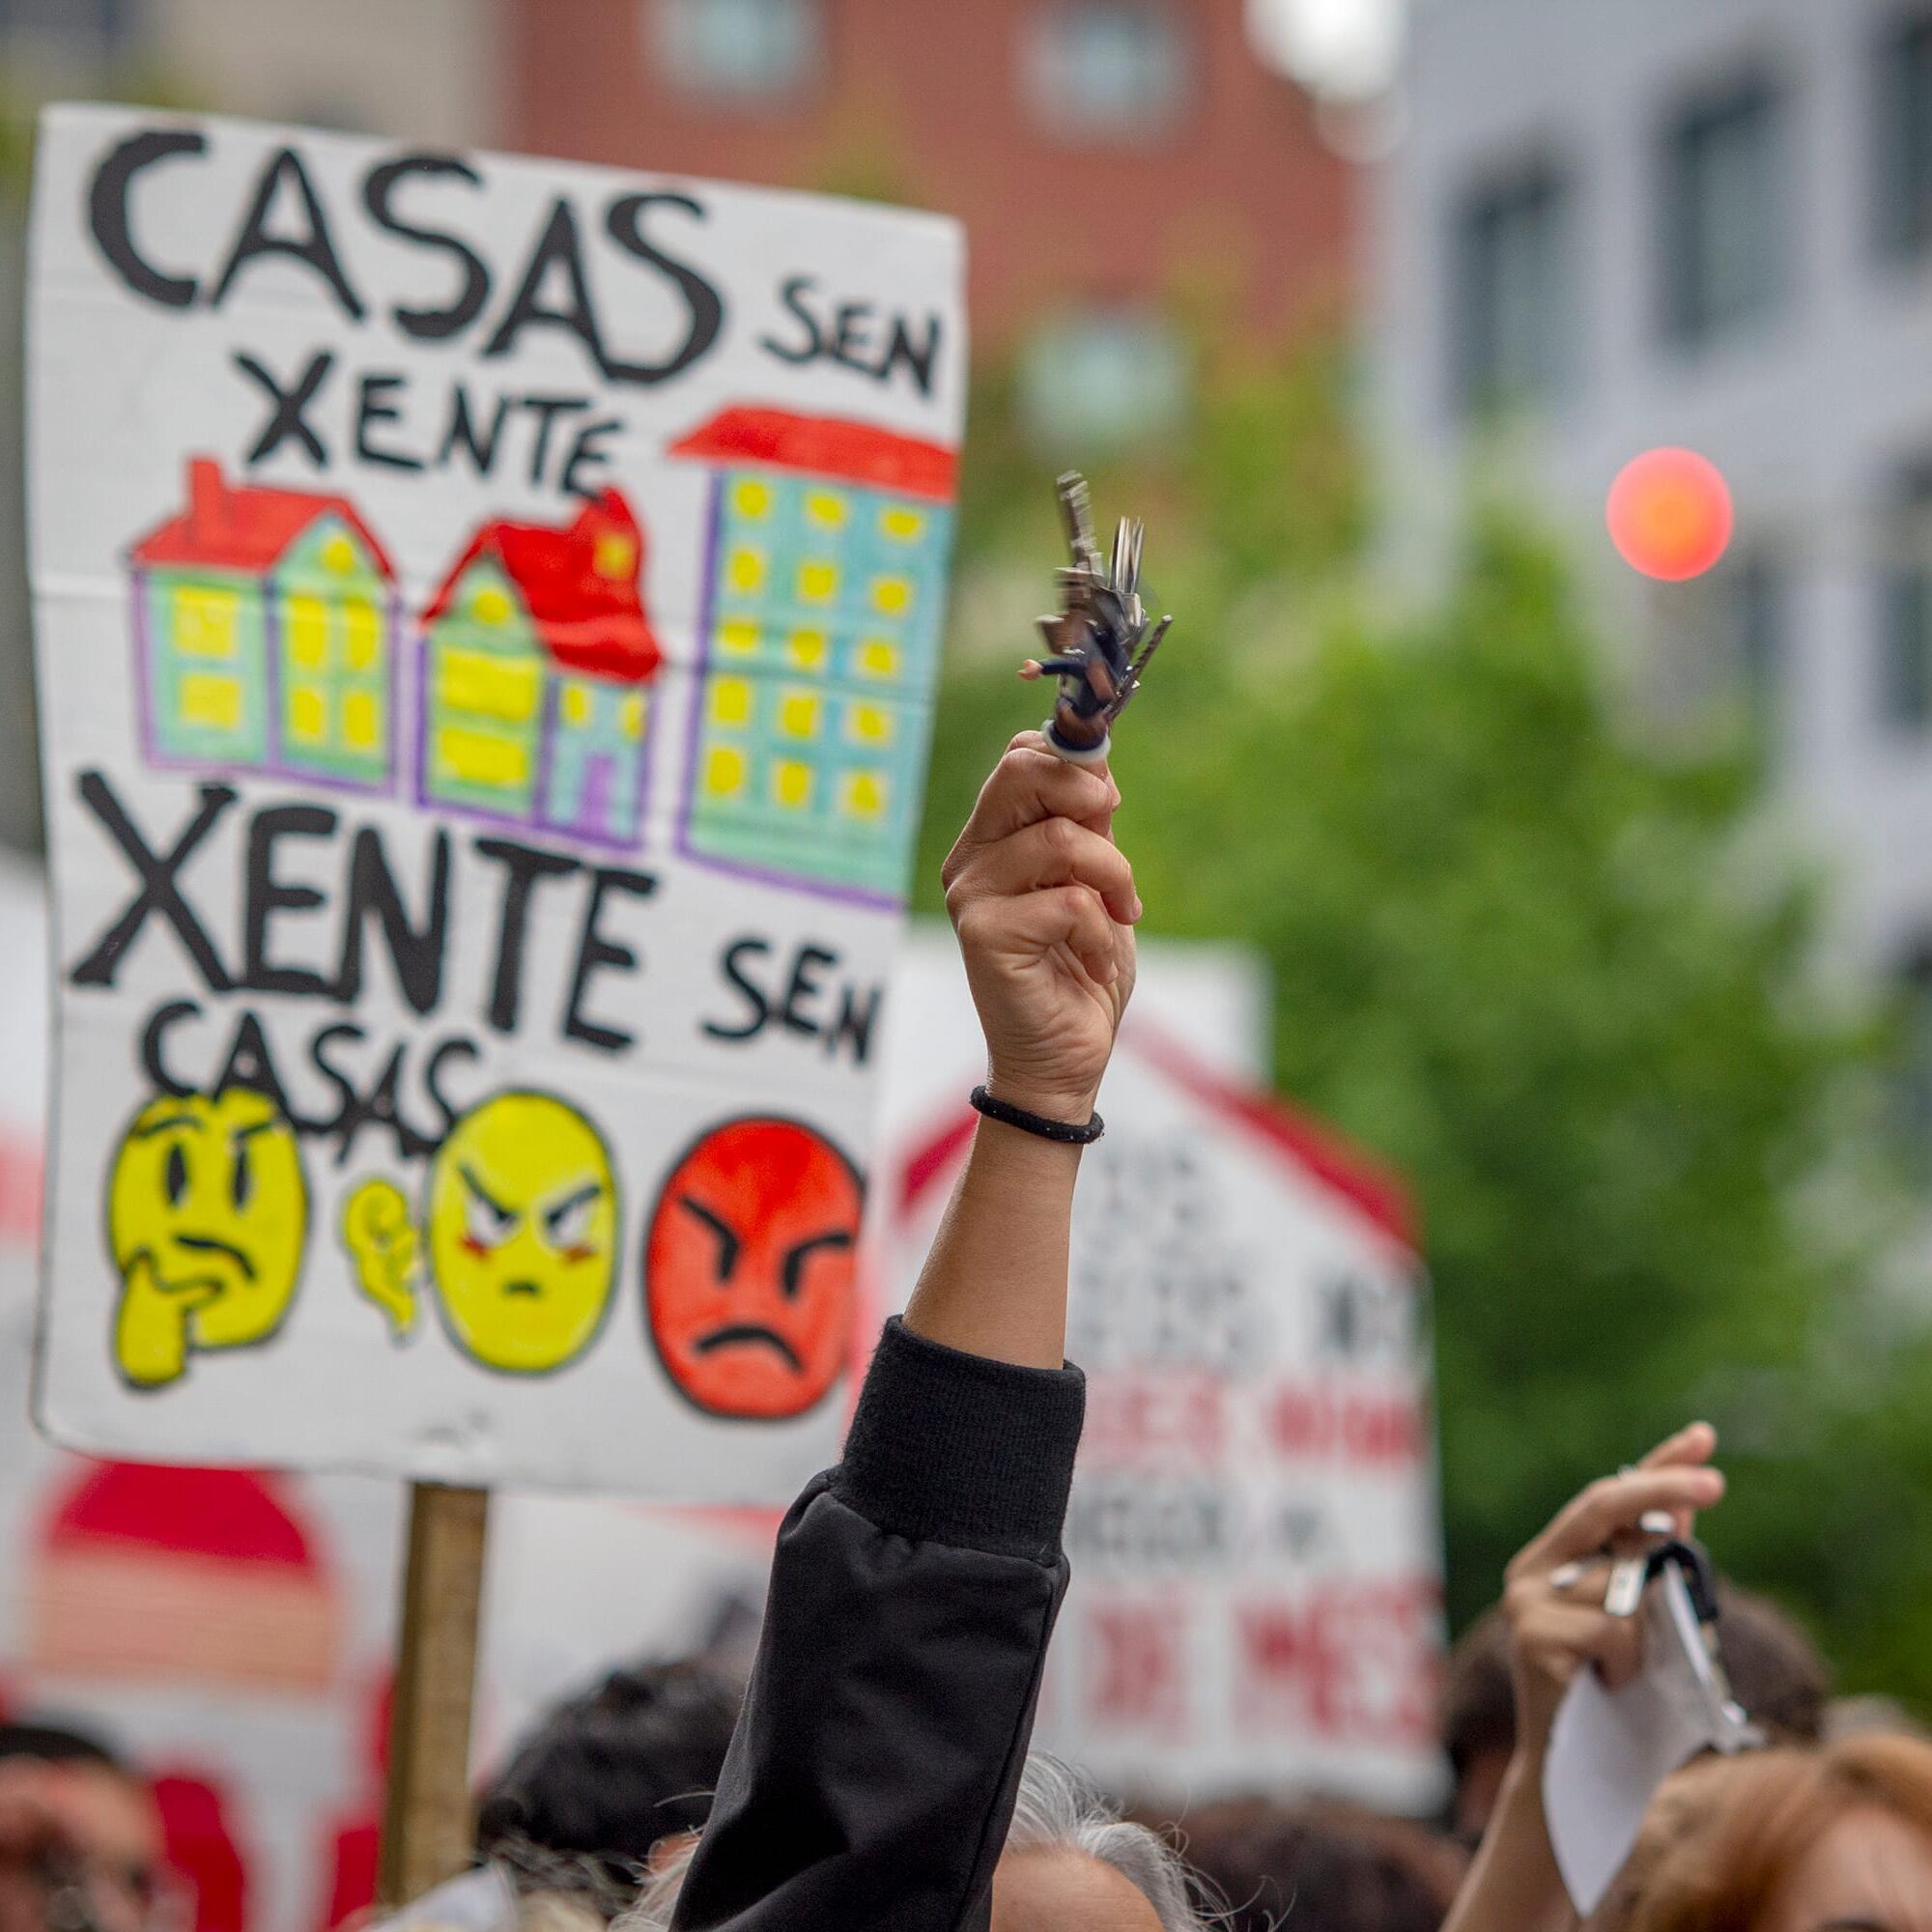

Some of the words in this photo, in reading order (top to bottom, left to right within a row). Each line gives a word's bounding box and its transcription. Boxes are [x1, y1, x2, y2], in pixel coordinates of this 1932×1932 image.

[87, 128, 724, 384] CASAS
[758, 274, 945, 400] SEN
[232, 350, 623, 504] XENTE
[68, 768, 661, 1055] XENTE
[702, 937, 885, 1065] SEN
[139, 1000, 483, 1167] CASAS
